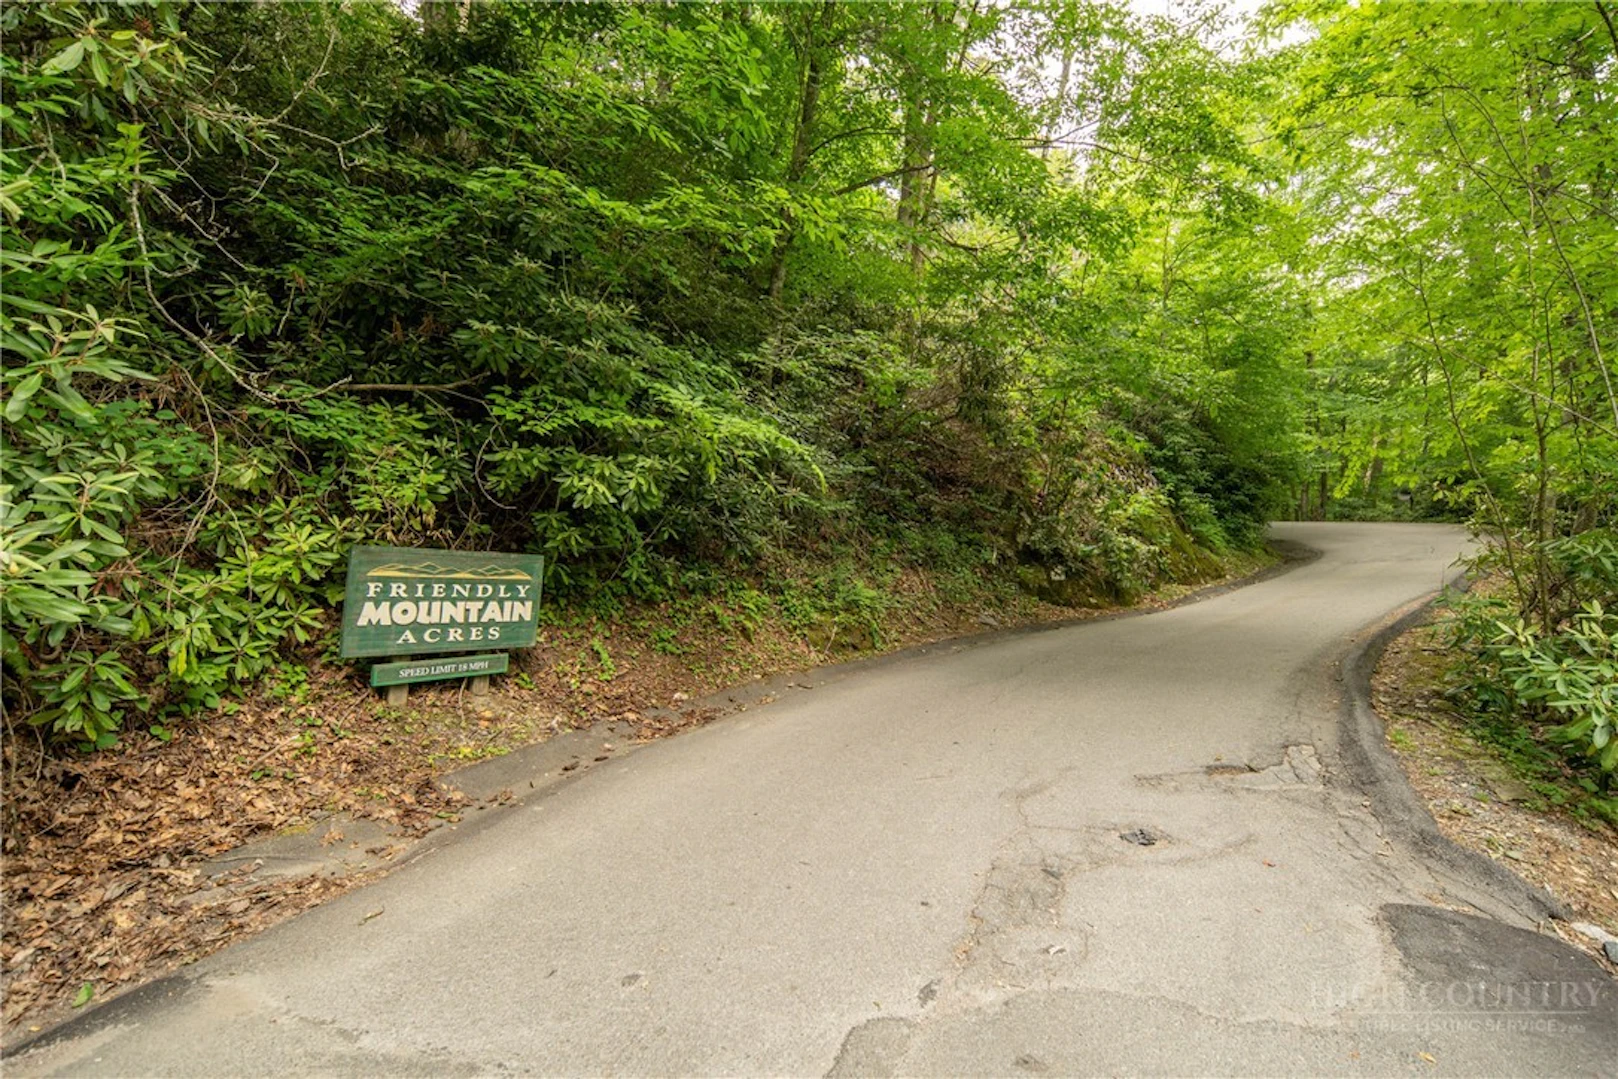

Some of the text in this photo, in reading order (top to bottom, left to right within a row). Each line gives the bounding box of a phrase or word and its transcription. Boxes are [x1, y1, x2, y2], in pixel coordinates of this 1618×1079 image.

[366, 582, 531, 598] FRIENDLY
[356, 600, 533, 626] MOUNTAIN
[396, 627, 500, 644] ACRES
[399, 660, 489, 678] SPEED LIMIT 18 MPH
